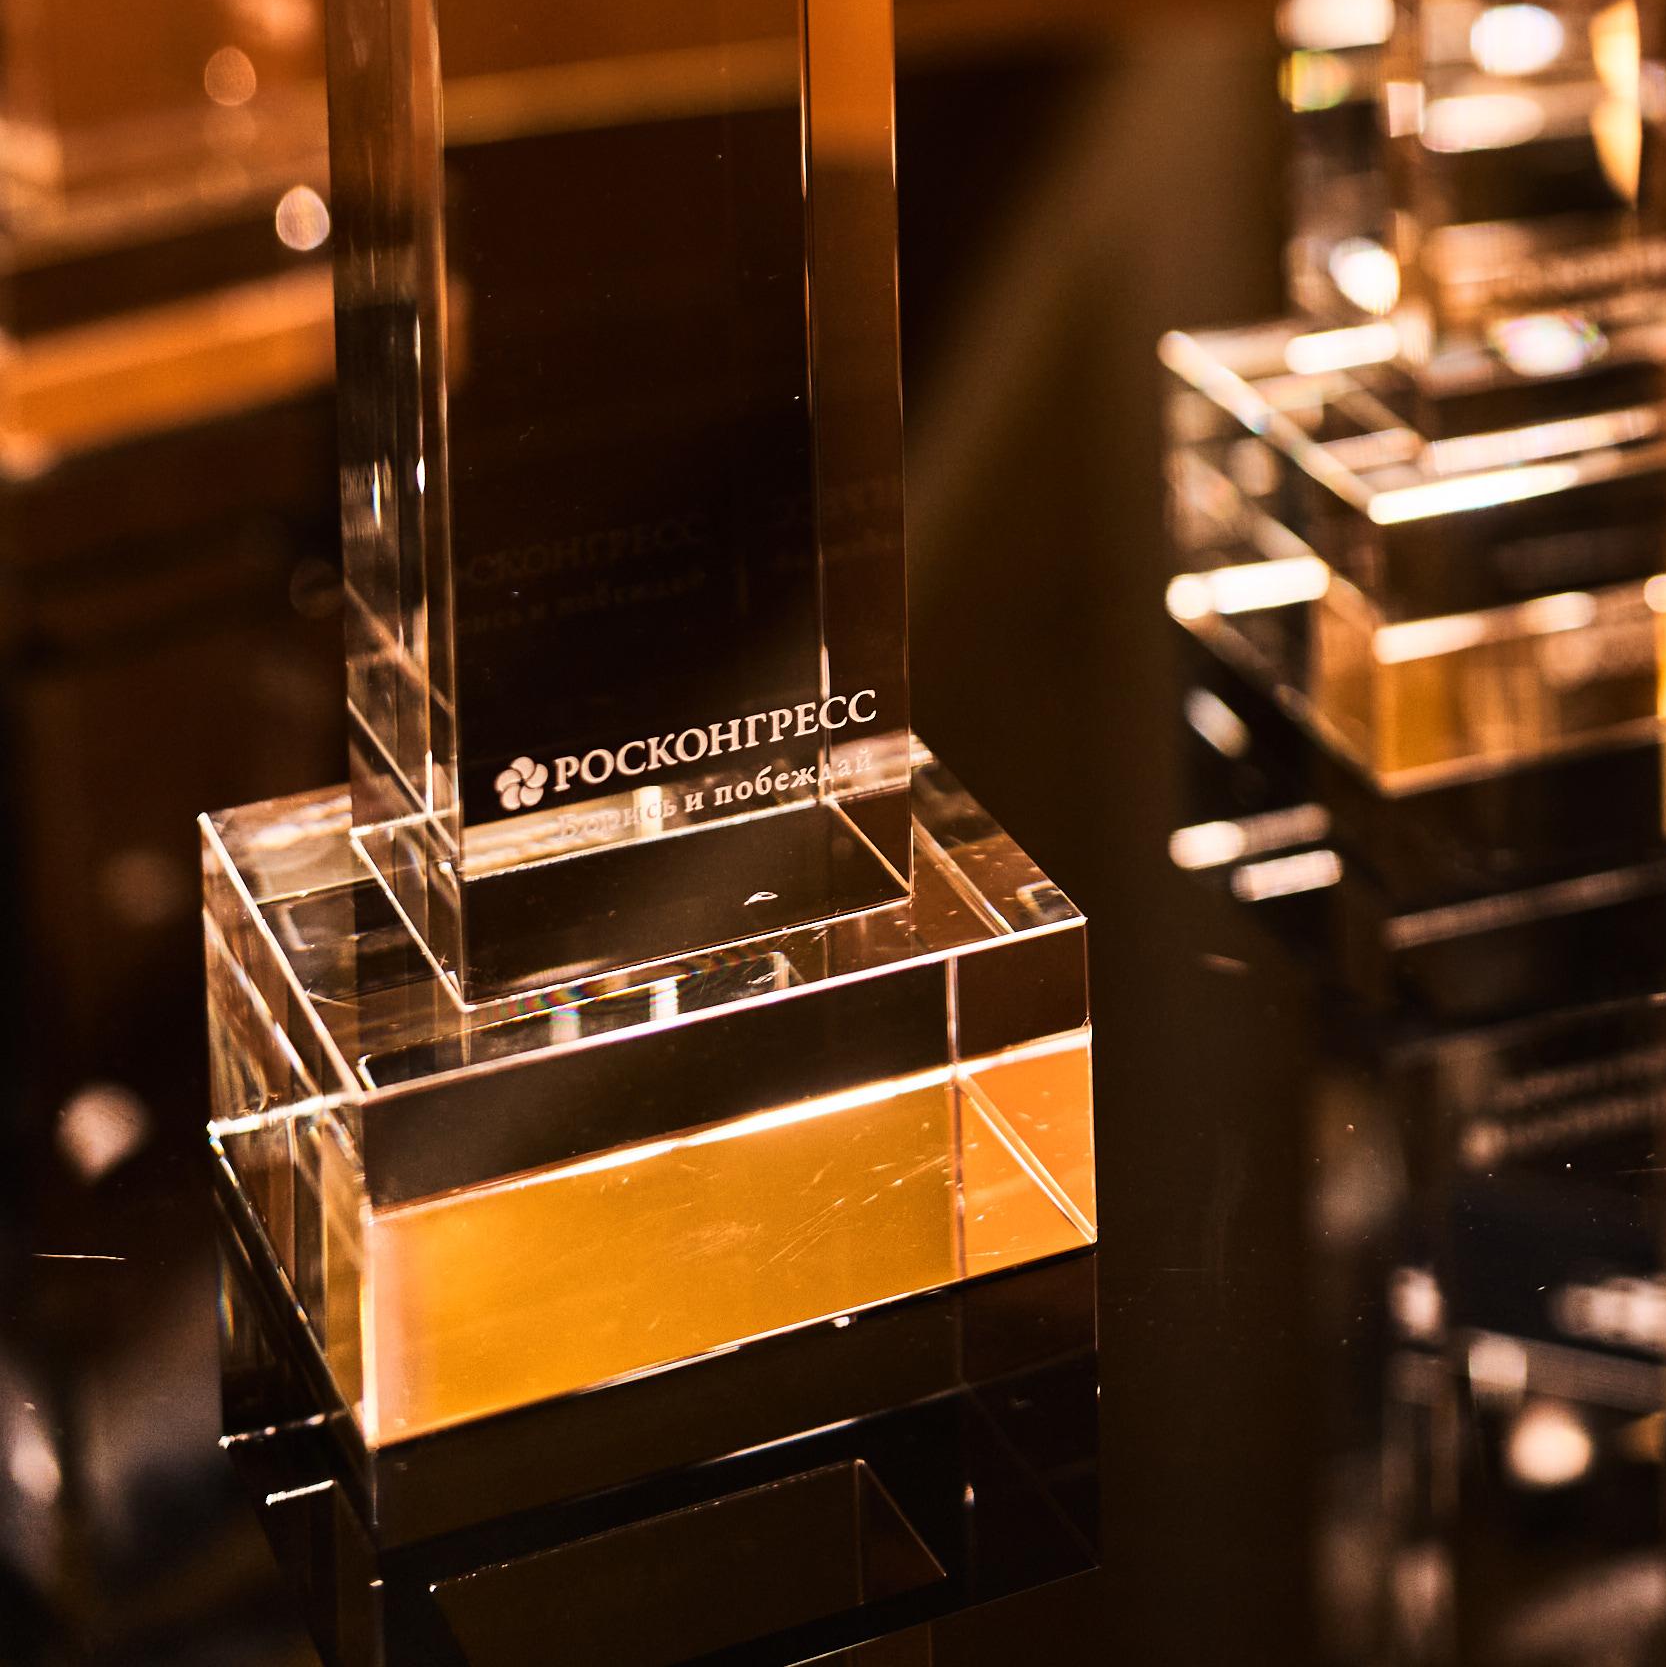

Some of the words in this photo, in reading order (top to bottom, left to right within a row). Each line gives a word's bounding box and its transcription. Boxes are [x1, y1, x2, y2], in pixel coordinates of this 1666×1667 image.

[552, 688, 878, 793] РОСКОНГРЕСС
[683, 791, 705, 814] и
[713, 748, 875, 807] побеждай
